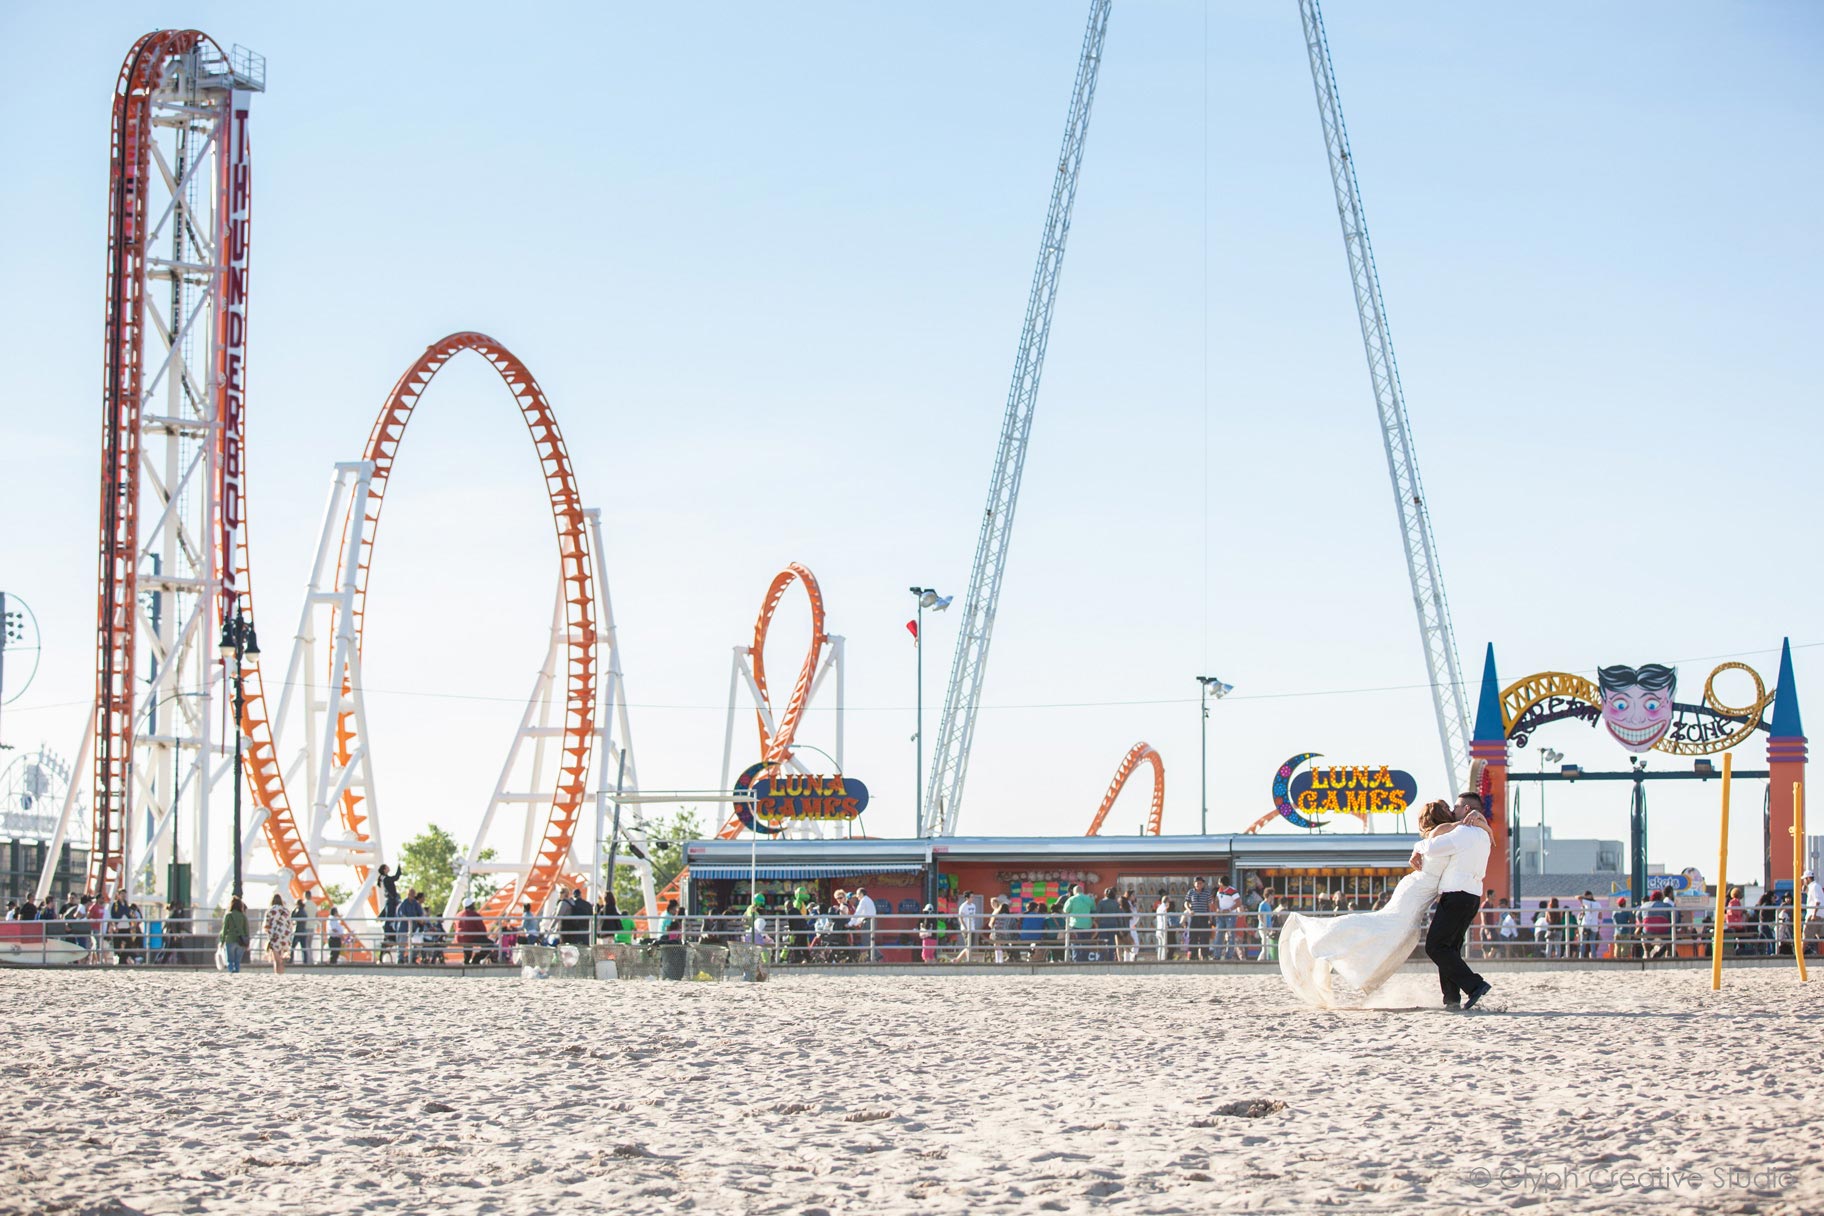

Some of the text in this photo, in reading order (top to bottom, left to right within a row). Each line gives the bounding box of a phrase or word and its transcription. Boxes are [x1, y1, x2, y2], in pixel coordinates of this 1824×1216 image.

[769, 773, 847, 796] LUNA
[1310, 765, 1394, 789] LUNA
[757, 797, 859, 821] GAMES
[1298, 789, 1407, 815] GAMES
